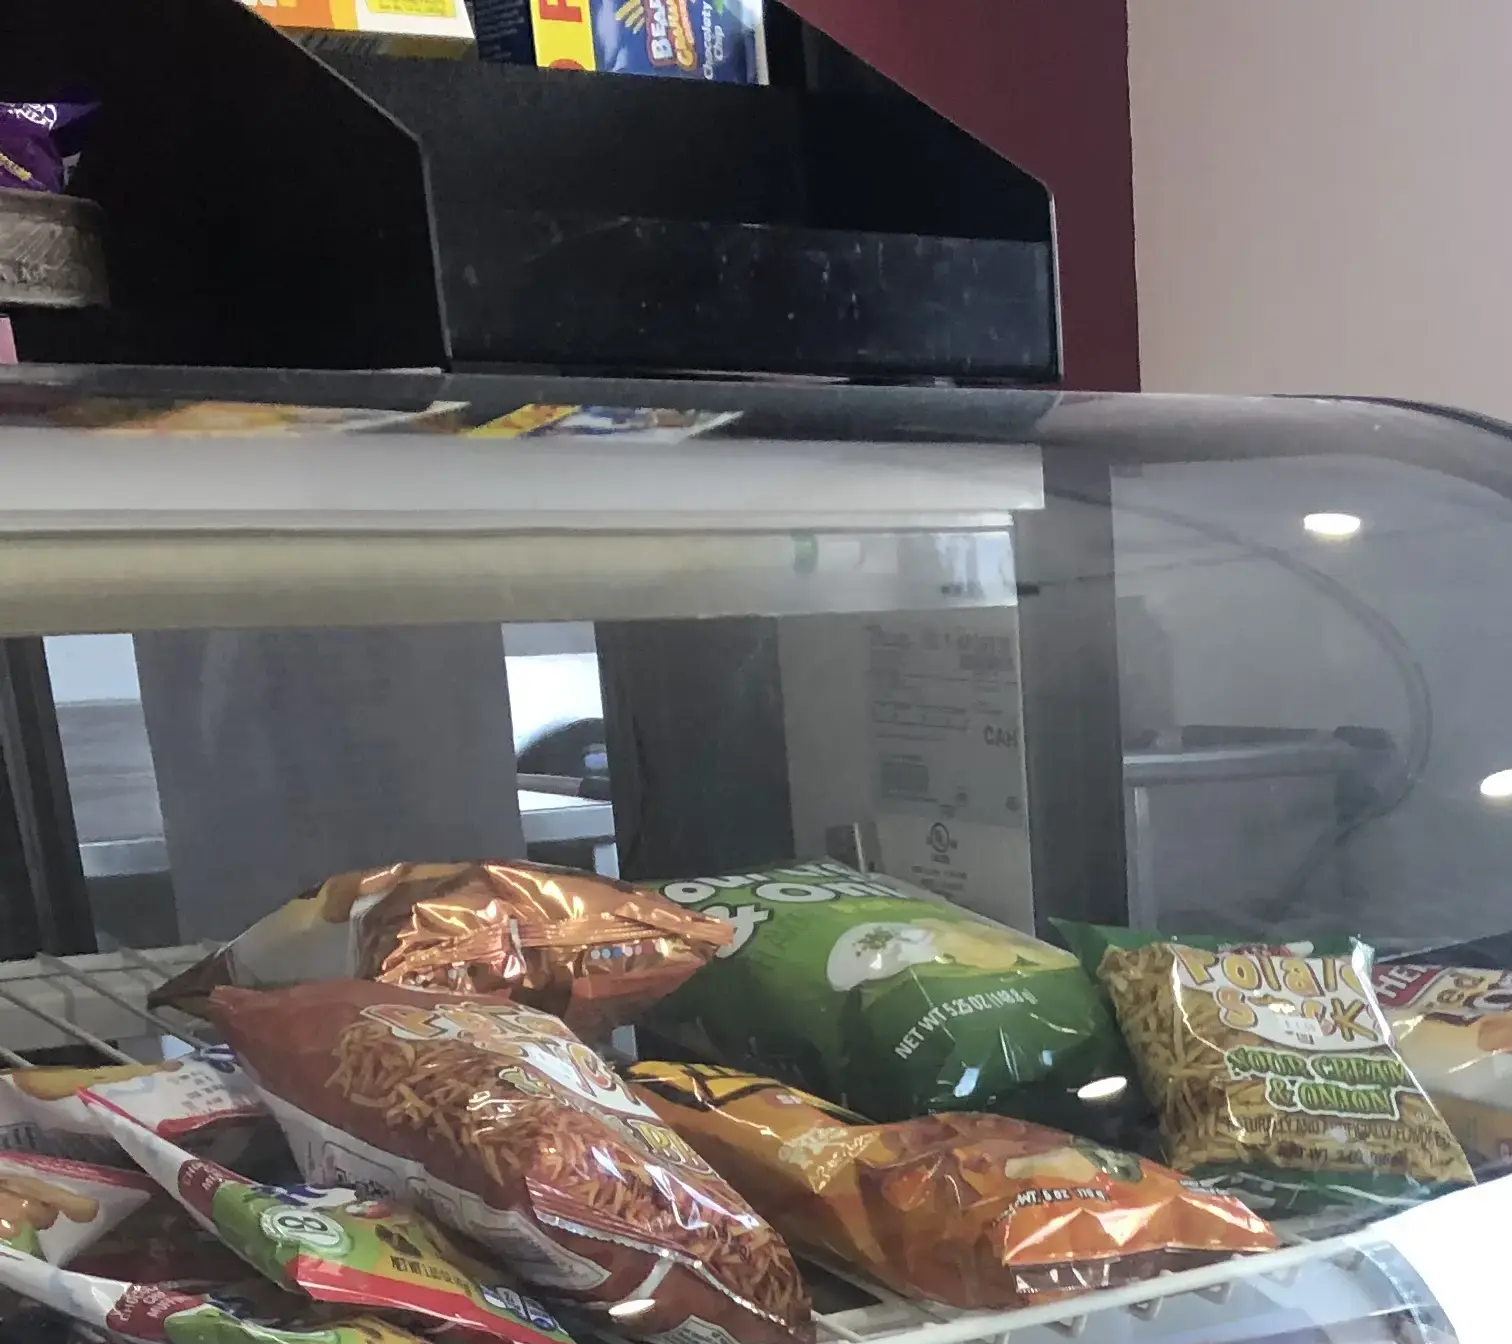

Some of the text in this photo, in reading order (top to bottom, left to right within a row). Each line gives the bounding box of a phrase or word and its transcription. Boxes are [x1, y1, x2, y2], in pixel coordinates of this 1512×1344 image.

[701, 2, 714, 79] Chocolaty
[714, 25, 725, 60] Chip
[894, 1029, 926, 1060] NET
[917, 1007, 948, 1033] WT
[970, 993, 991, 1012] OZ
[1227, 1047, 1407, 1086] SOUR CREAM
[1268, 1077, 1391, 1113] & ONION
